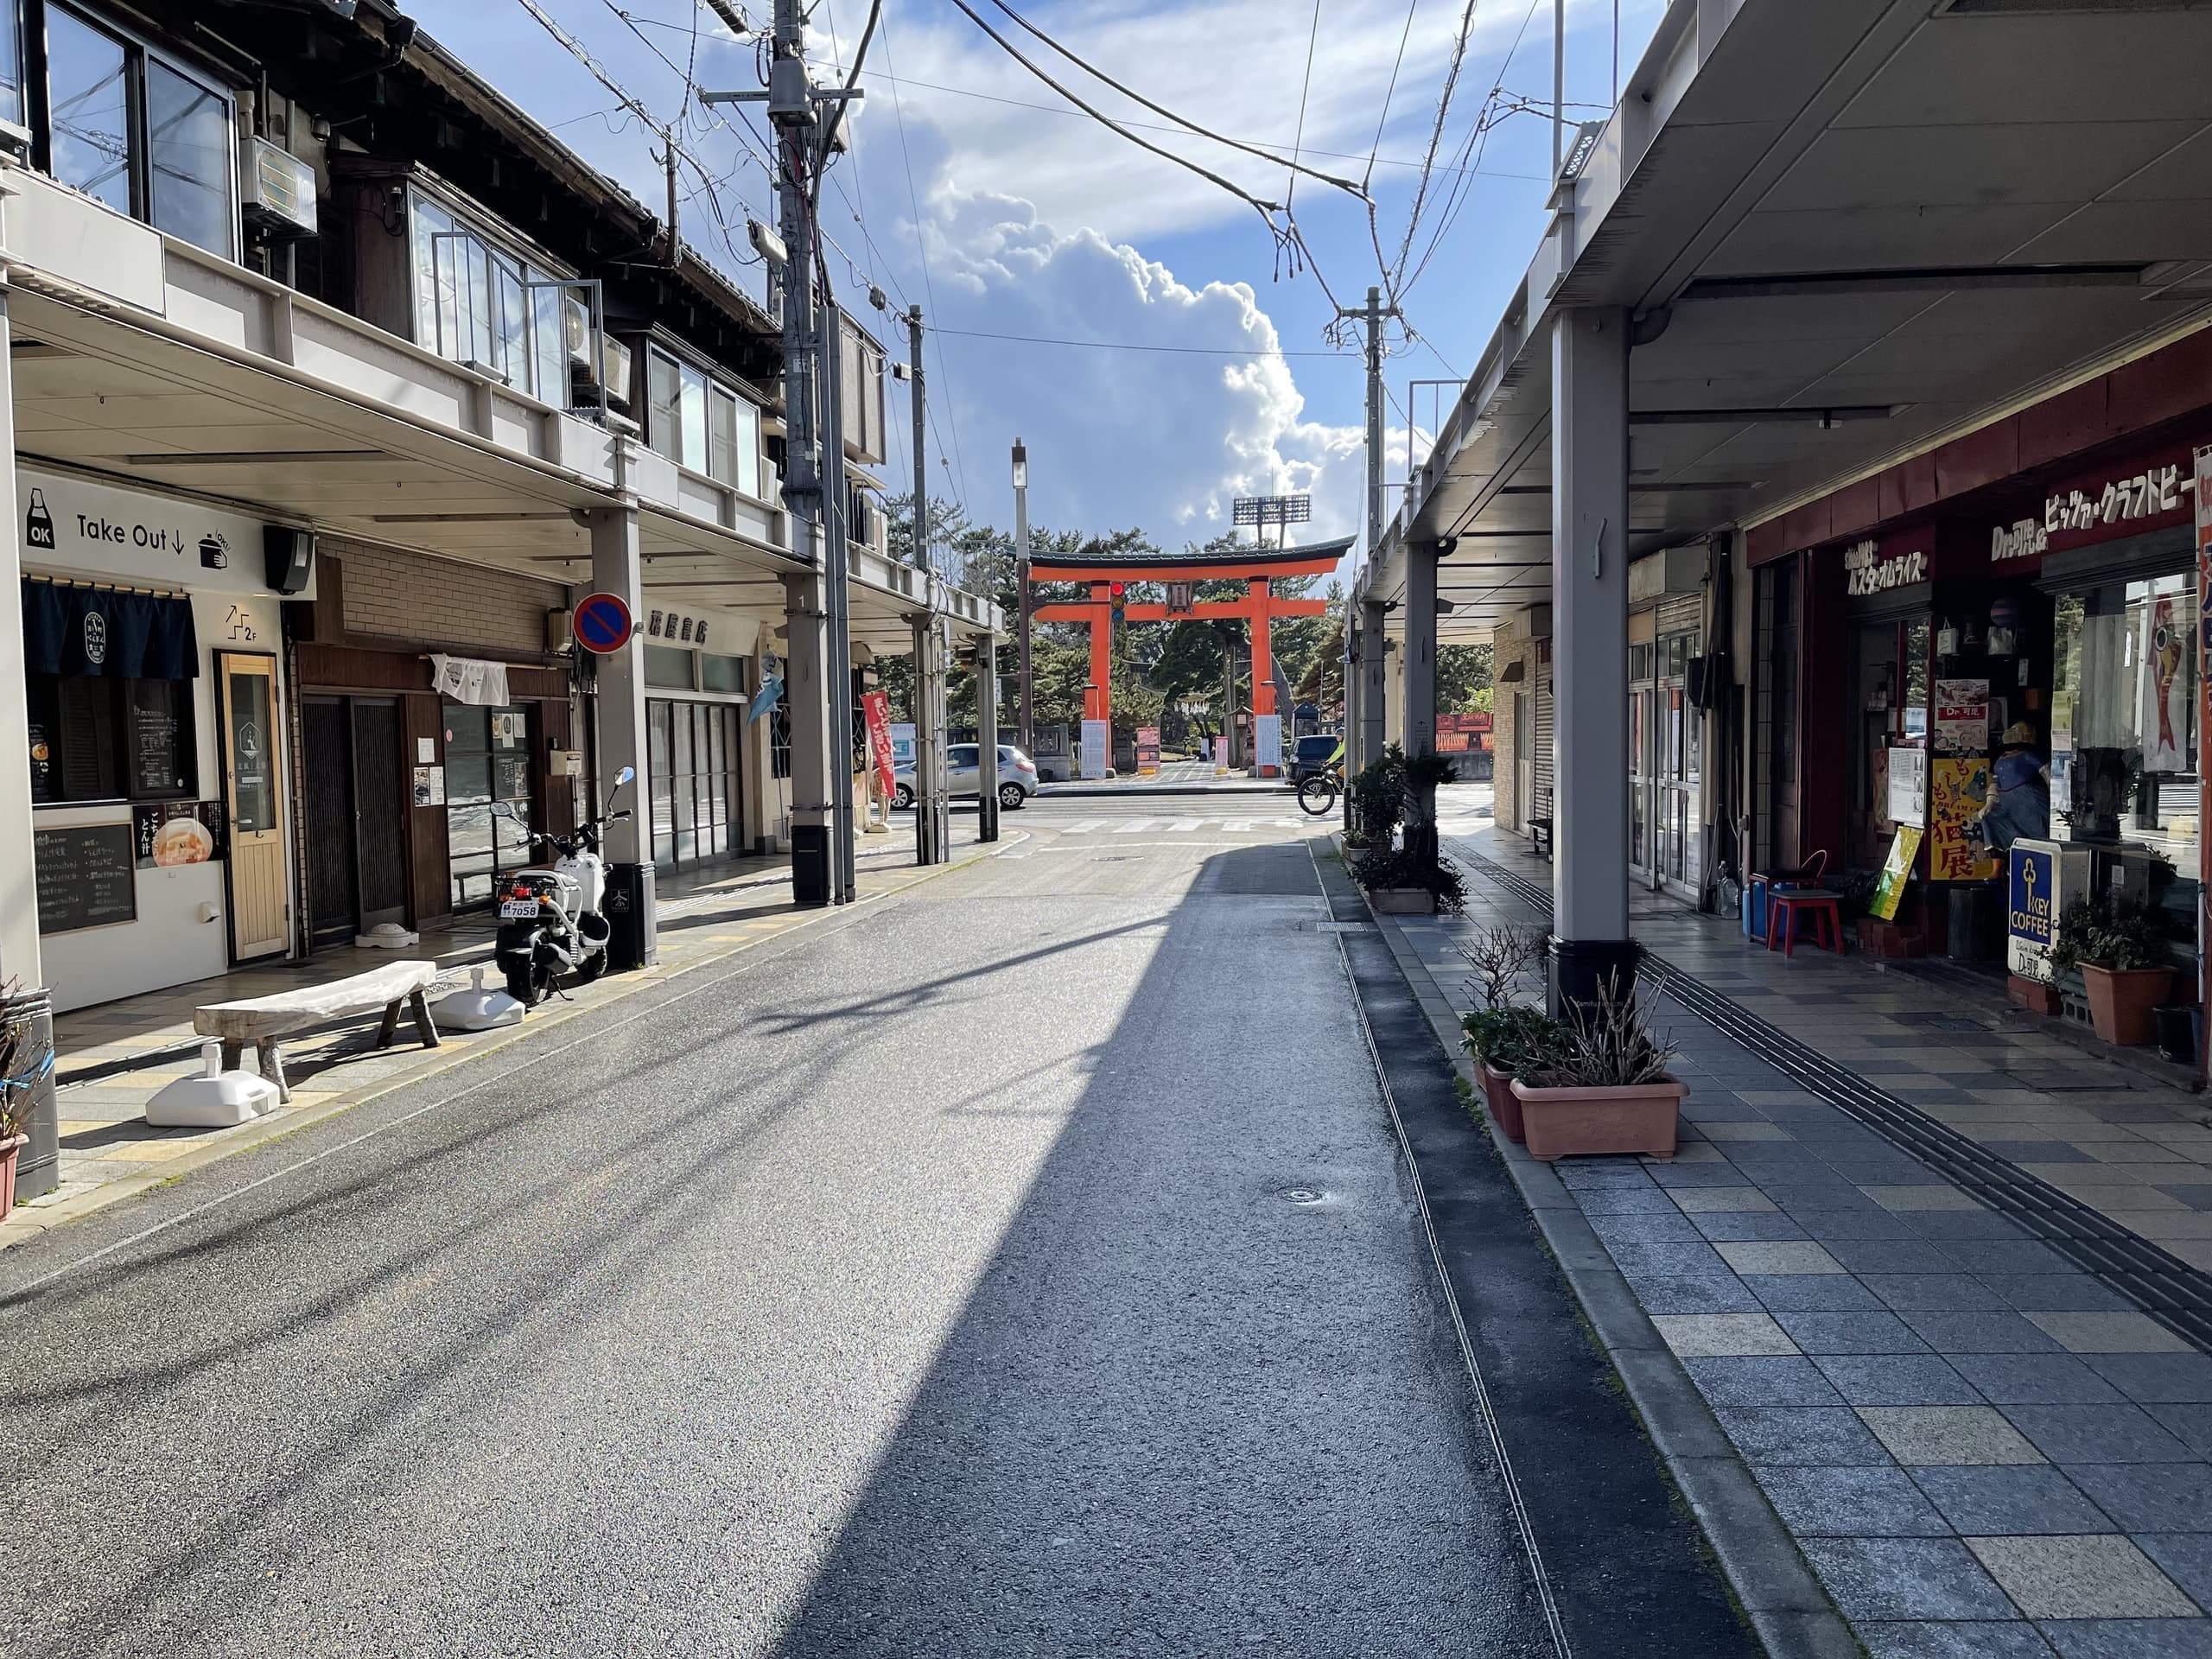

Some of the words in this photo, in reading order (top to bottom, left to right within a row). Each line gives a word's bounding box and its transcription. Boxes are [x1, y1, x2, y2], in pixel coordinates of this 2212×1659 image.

[30, 526, 51, 543] OK
[77, 514, 125, 543] Take
[132, 524, 167, 550] Out
[245, 626, 257, 642] 2F
[141, 818, 150, 855] とん汁
[1932, 813, 1974, 879] 猫展
[512, 907, 536, 916] 7058
[2031, 895, 2050, 917] KEY
[2011, 911, 2049, 938] COFFEE
